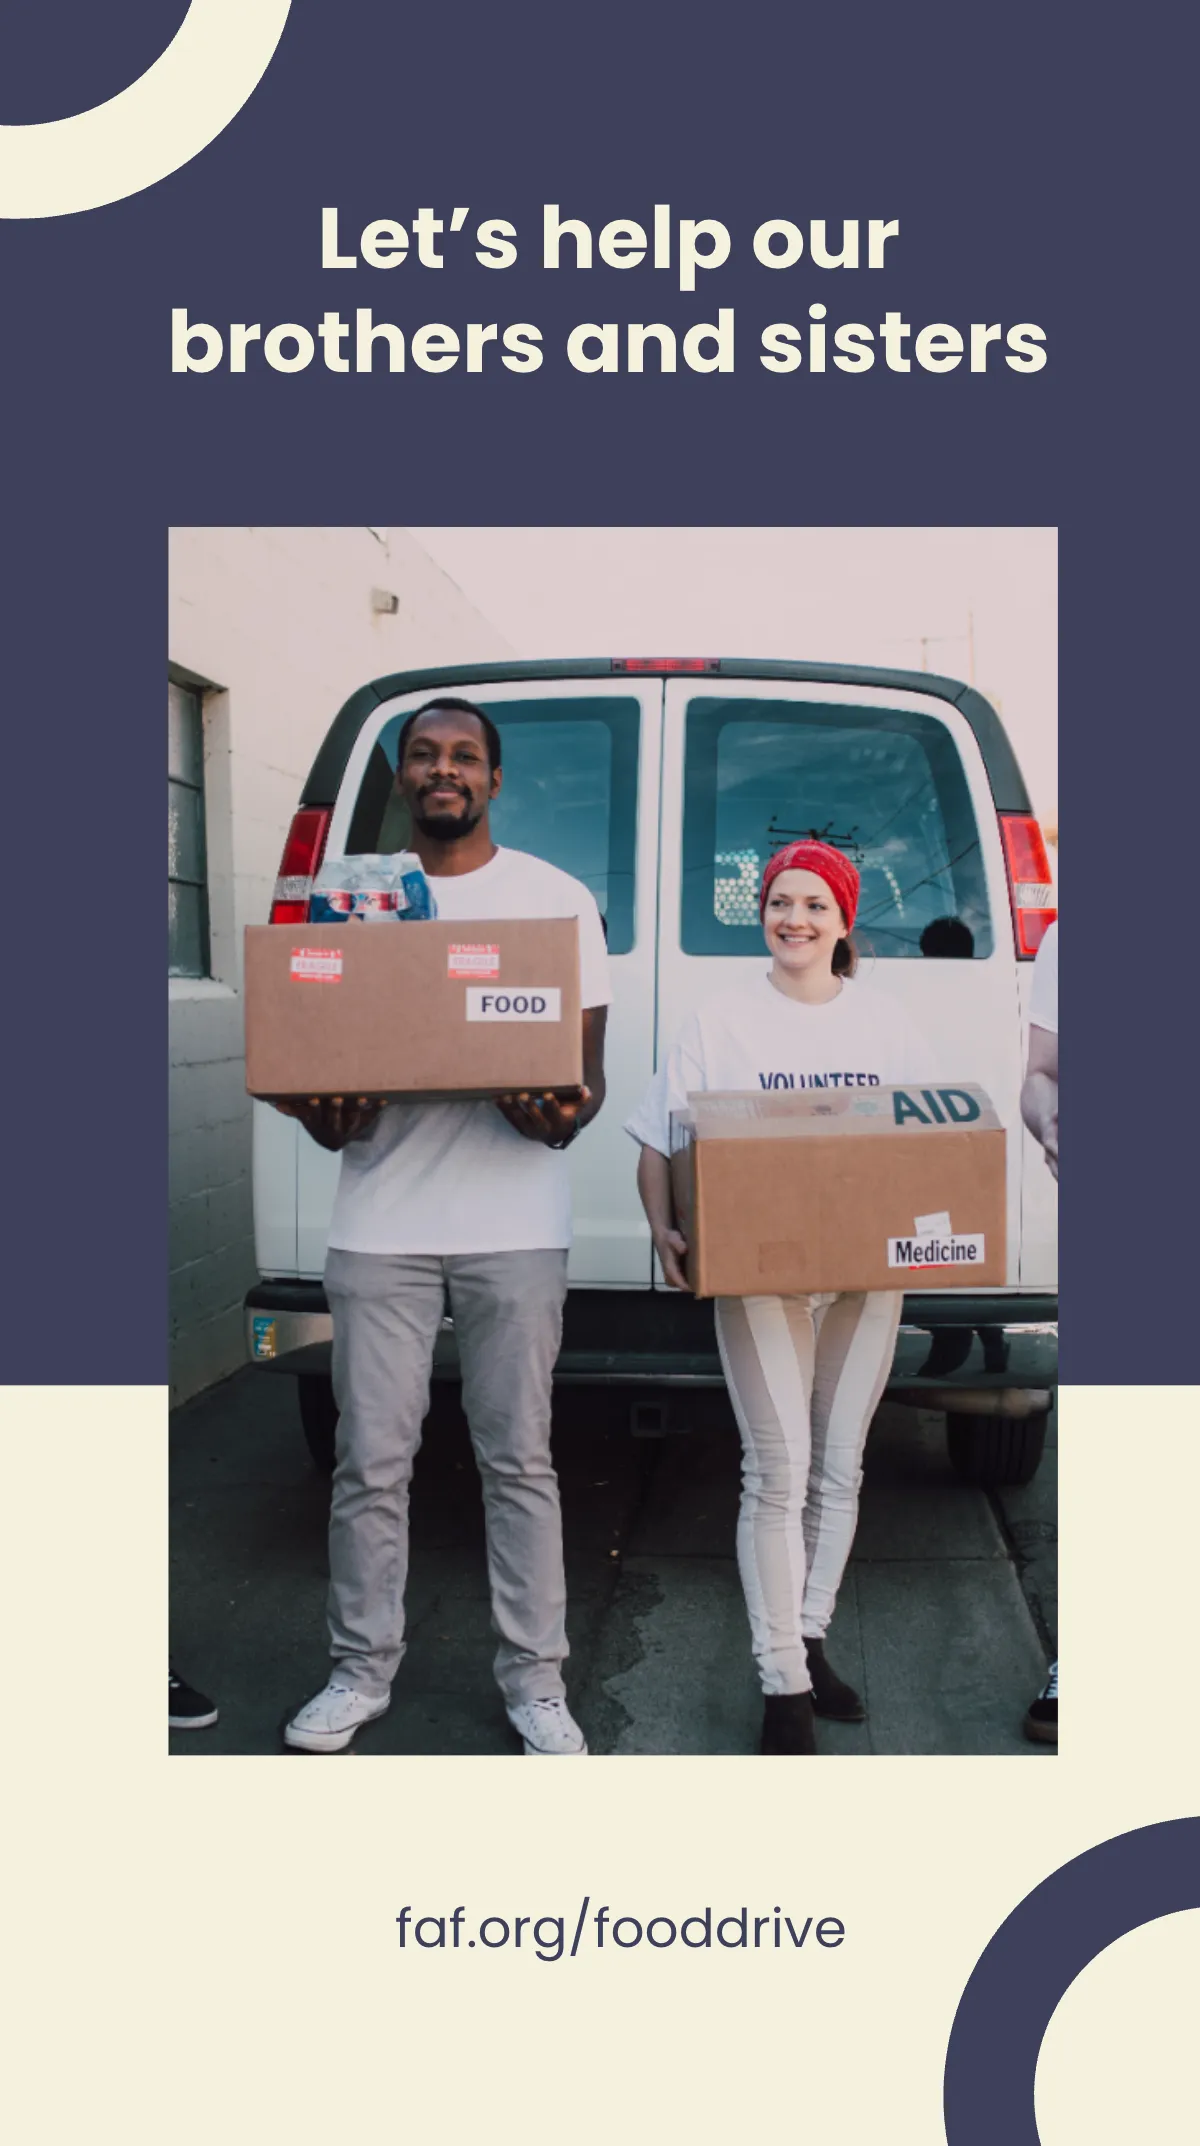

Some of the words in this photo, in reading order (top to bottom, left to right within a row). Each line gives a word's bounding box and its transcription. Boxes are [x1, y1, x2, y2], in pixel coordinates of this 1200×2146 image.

[481, 995, 546, 1014] FOOD
[892, 1088, 981, 1126] AID
[895, 1239, 977, 1264] Medicine
